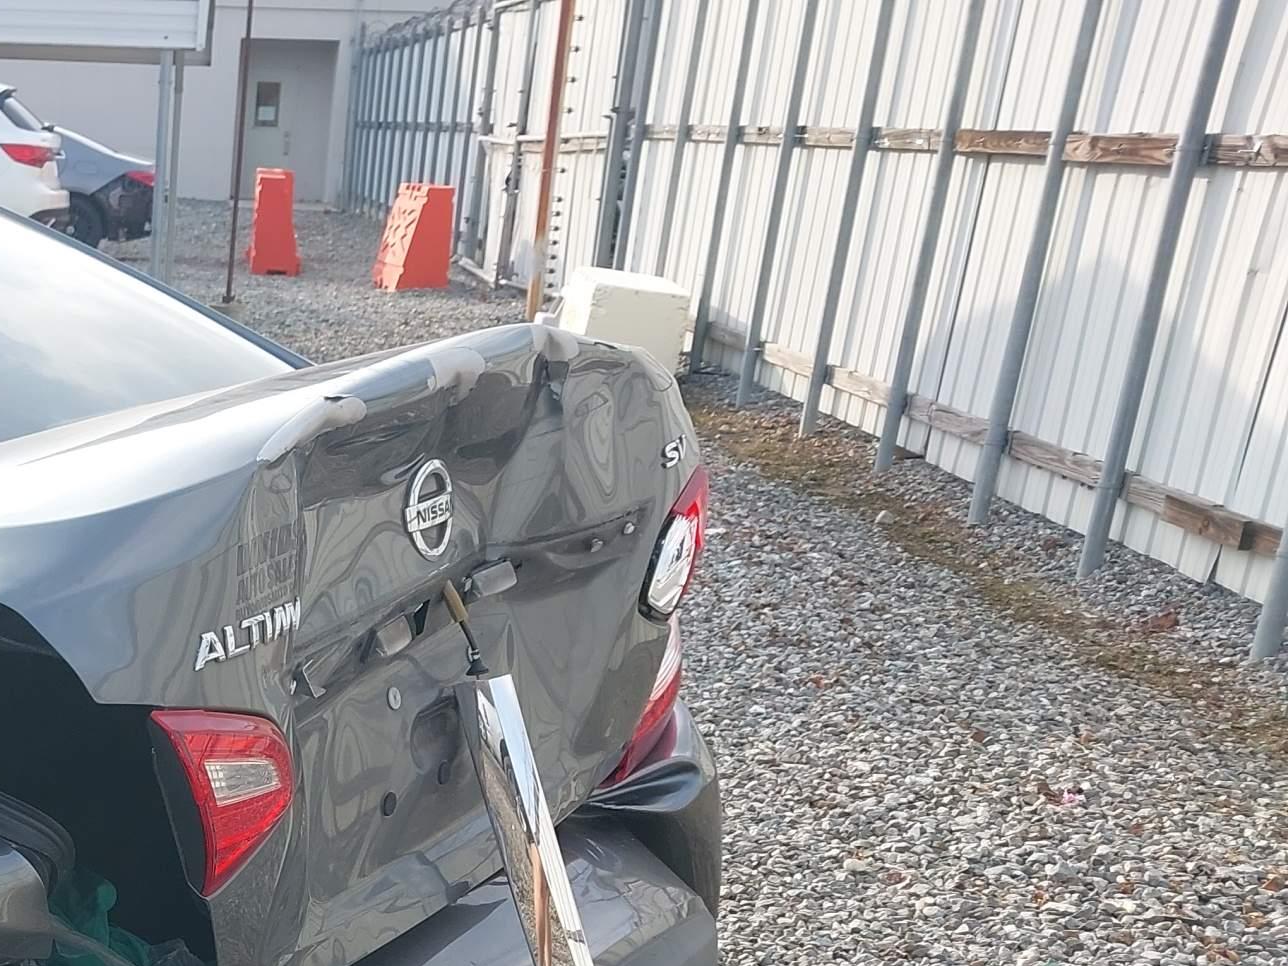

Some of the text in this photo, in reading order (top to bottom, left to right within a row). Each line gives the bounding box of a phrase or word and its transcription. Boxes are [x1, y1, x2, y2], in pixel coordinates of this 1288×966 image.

[663, 433, 688, 469] SV
[416, 498, 450, 526] NISSA
[195, 596, 301, 671] ALTIM
